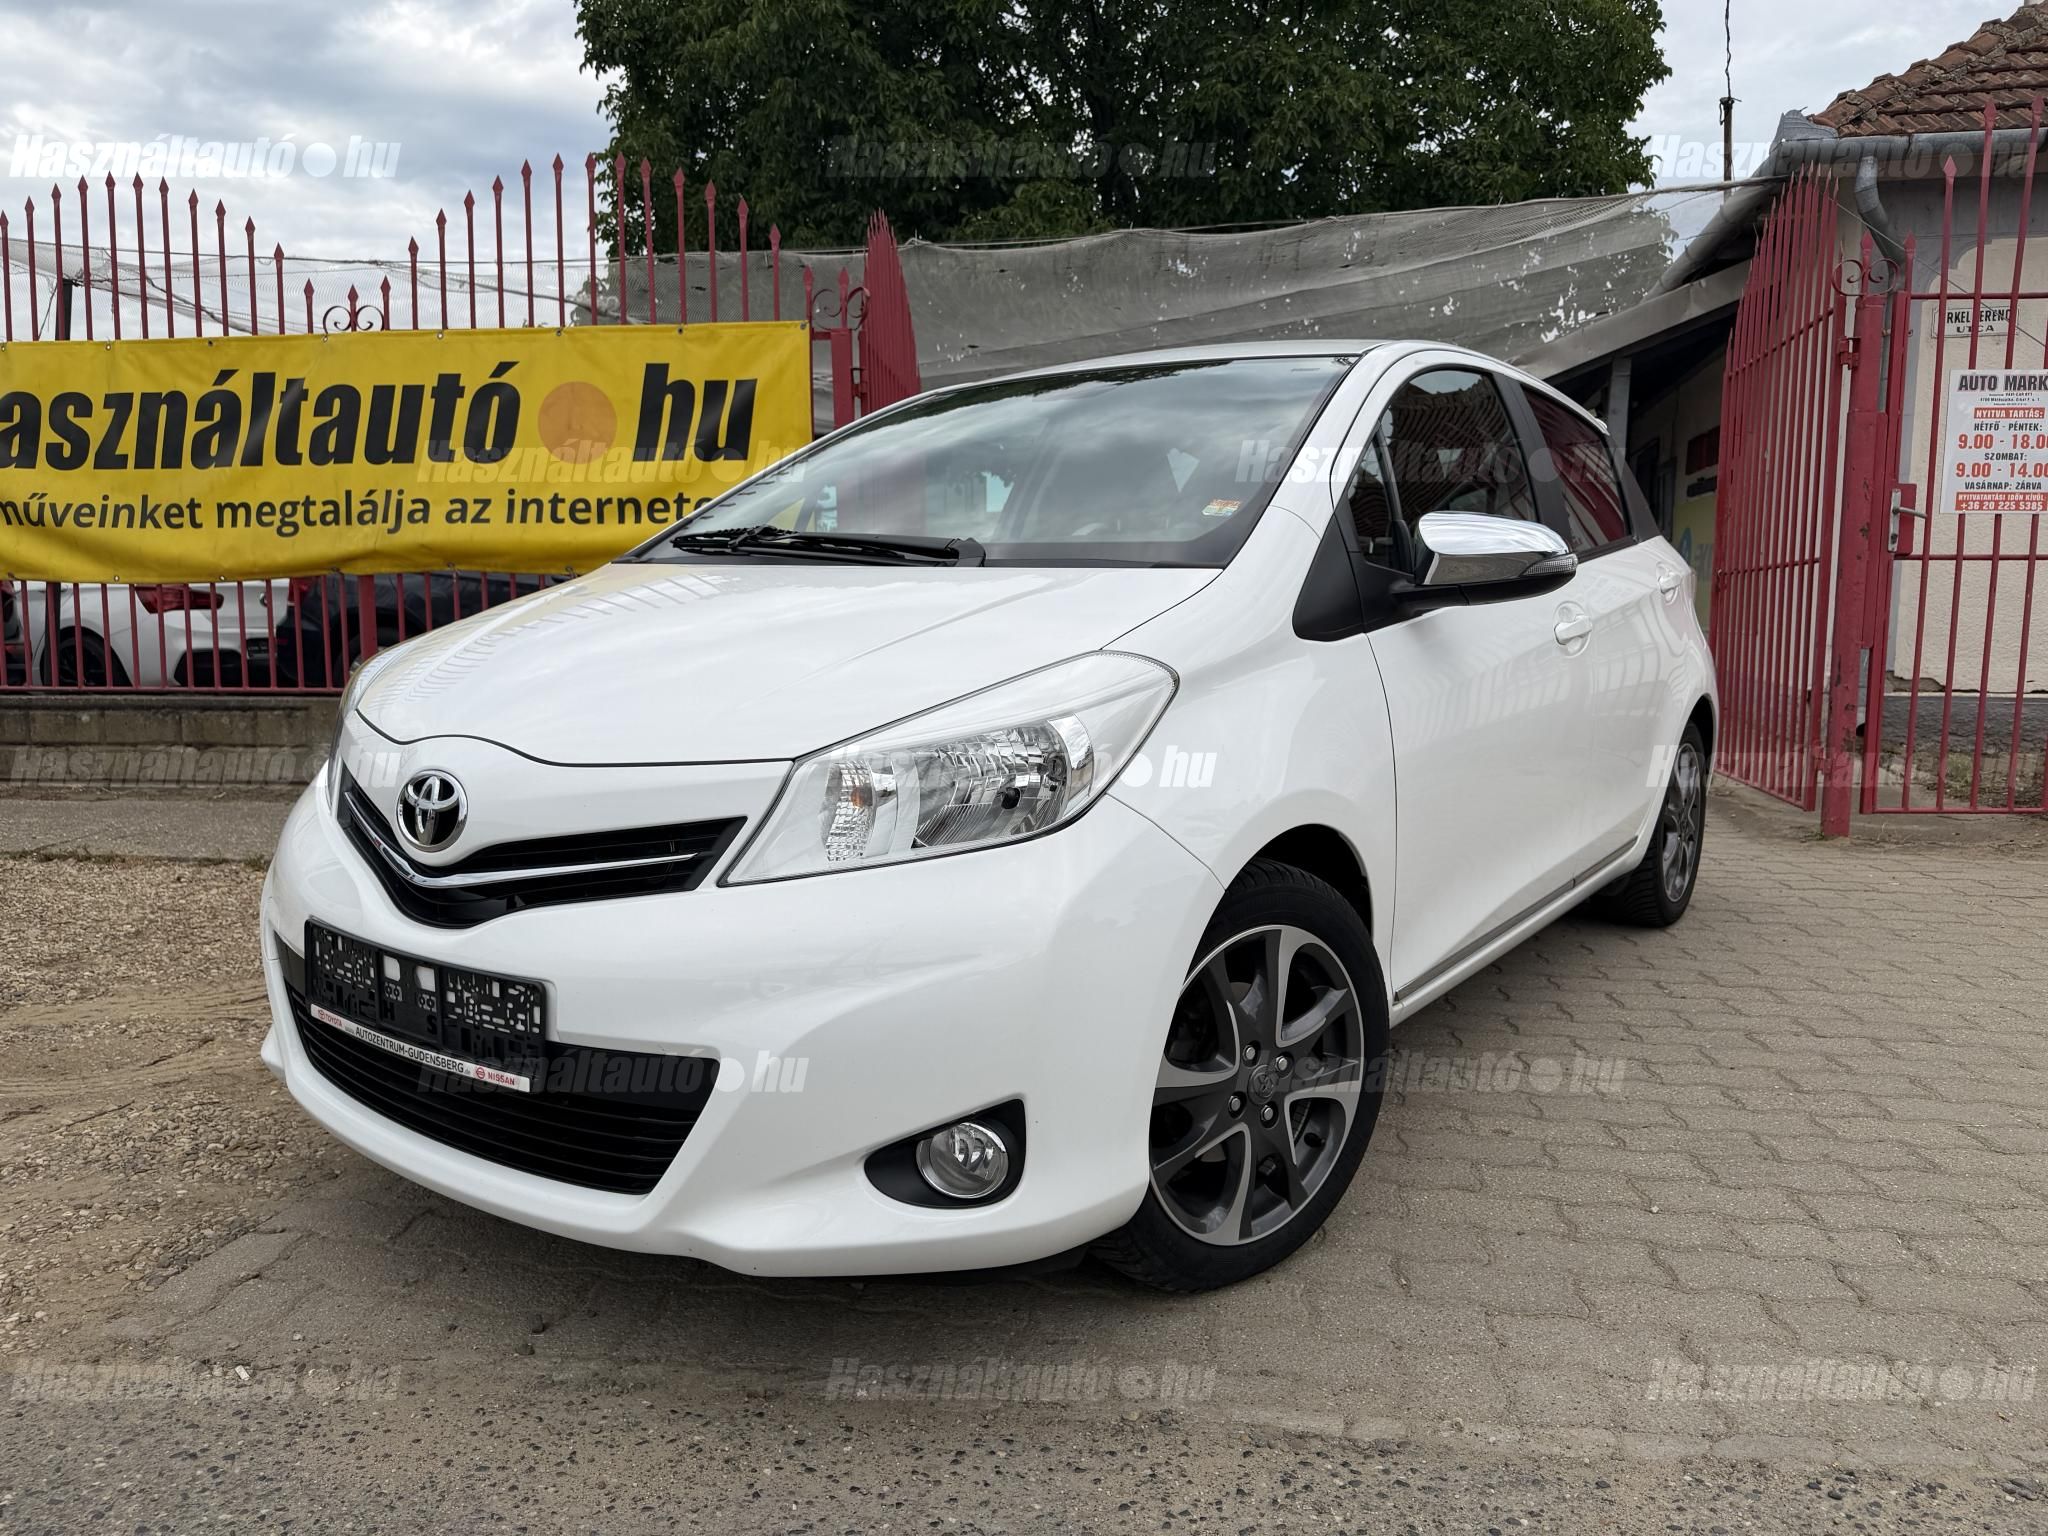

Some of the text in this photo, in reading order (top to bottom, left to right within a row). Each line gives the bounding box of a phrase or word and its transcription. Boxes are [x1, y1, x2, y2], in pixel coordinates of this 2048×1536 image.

[1946, 311, 1971, 324] RKEL
[1958, 375, 1997, 391] AUTO
[2008, 422, 2042, 431] PÉNTEK:
[1958, 434, 1993, 449] 9.00
[2012, 434, 2048, 449] 18.0
[1984, 452, 2027, 460] SZOMBAT:
[1956, 463, 1991, 477] 9.00
[1965, 479, 2042, 490] VASÁRNAP: ZÁRVA
[1961, 502, 1979, 510] +36
[1982, 502, 1995, 510] 20
[1998, 502, 2015, 510] 225
[0, 493, 202, 529] műveinket
[217, 489, 429, 537] megtalálja
[445, 499, 492, 525] az
[487, 1072, 515, 1086] NISSAN
